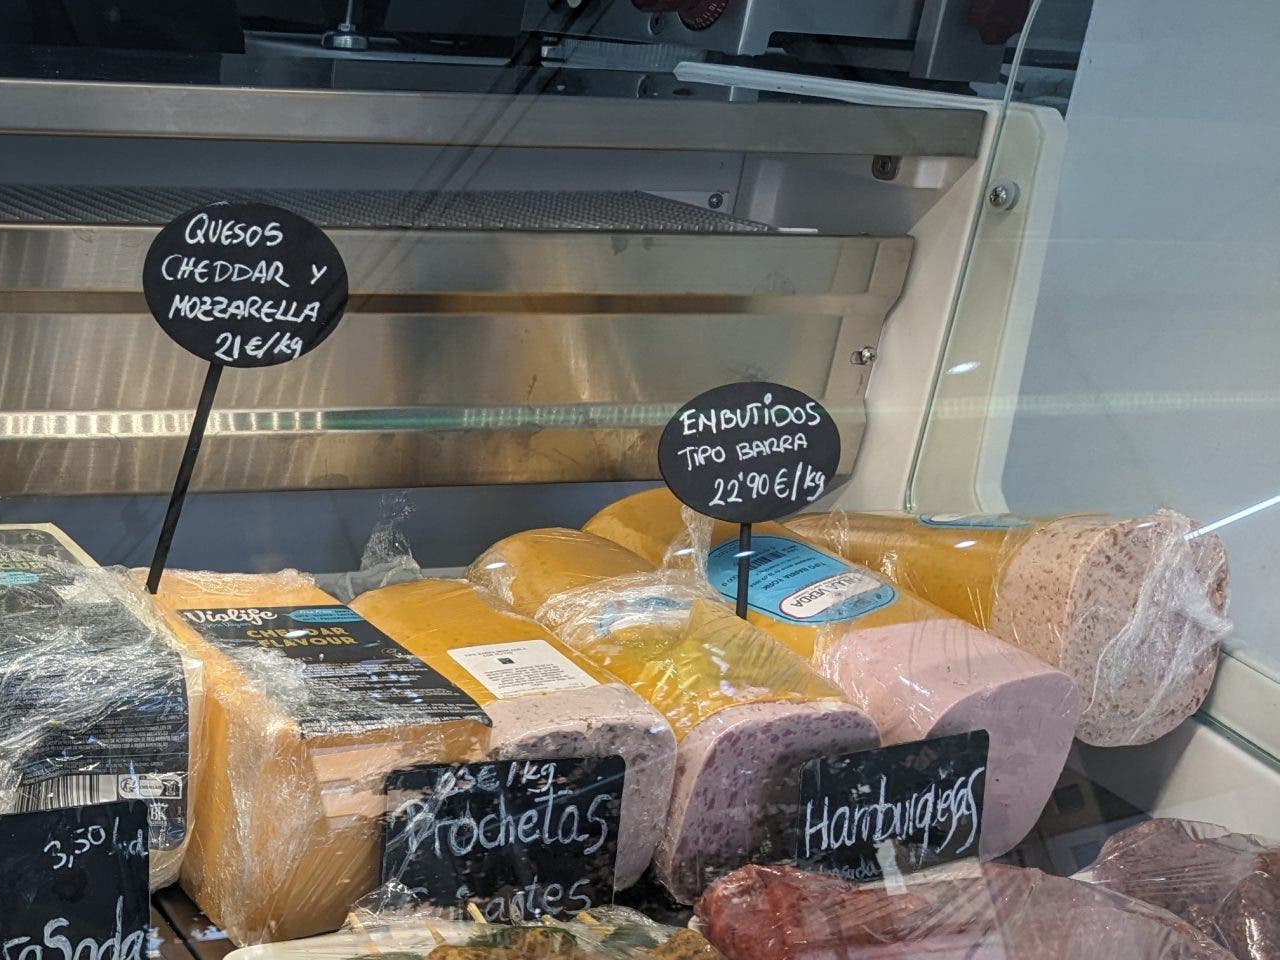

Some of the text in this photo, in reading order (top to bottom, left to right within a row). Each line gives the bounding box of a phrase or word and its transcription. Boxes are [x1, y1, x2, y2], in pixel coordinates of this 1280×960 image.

[185, 212, 284, 247] QUESOS
[161, 254, 290, 287] CHEDDAR
[168, 294, 320, 323] MOZZARELLA
[736, 433, 808, 461] BARRA
[183, 608, 278, 626] Violife
[246, 626, 349, 639] CHEDAR
[258, 636, 359, 648] FLAVOUR
